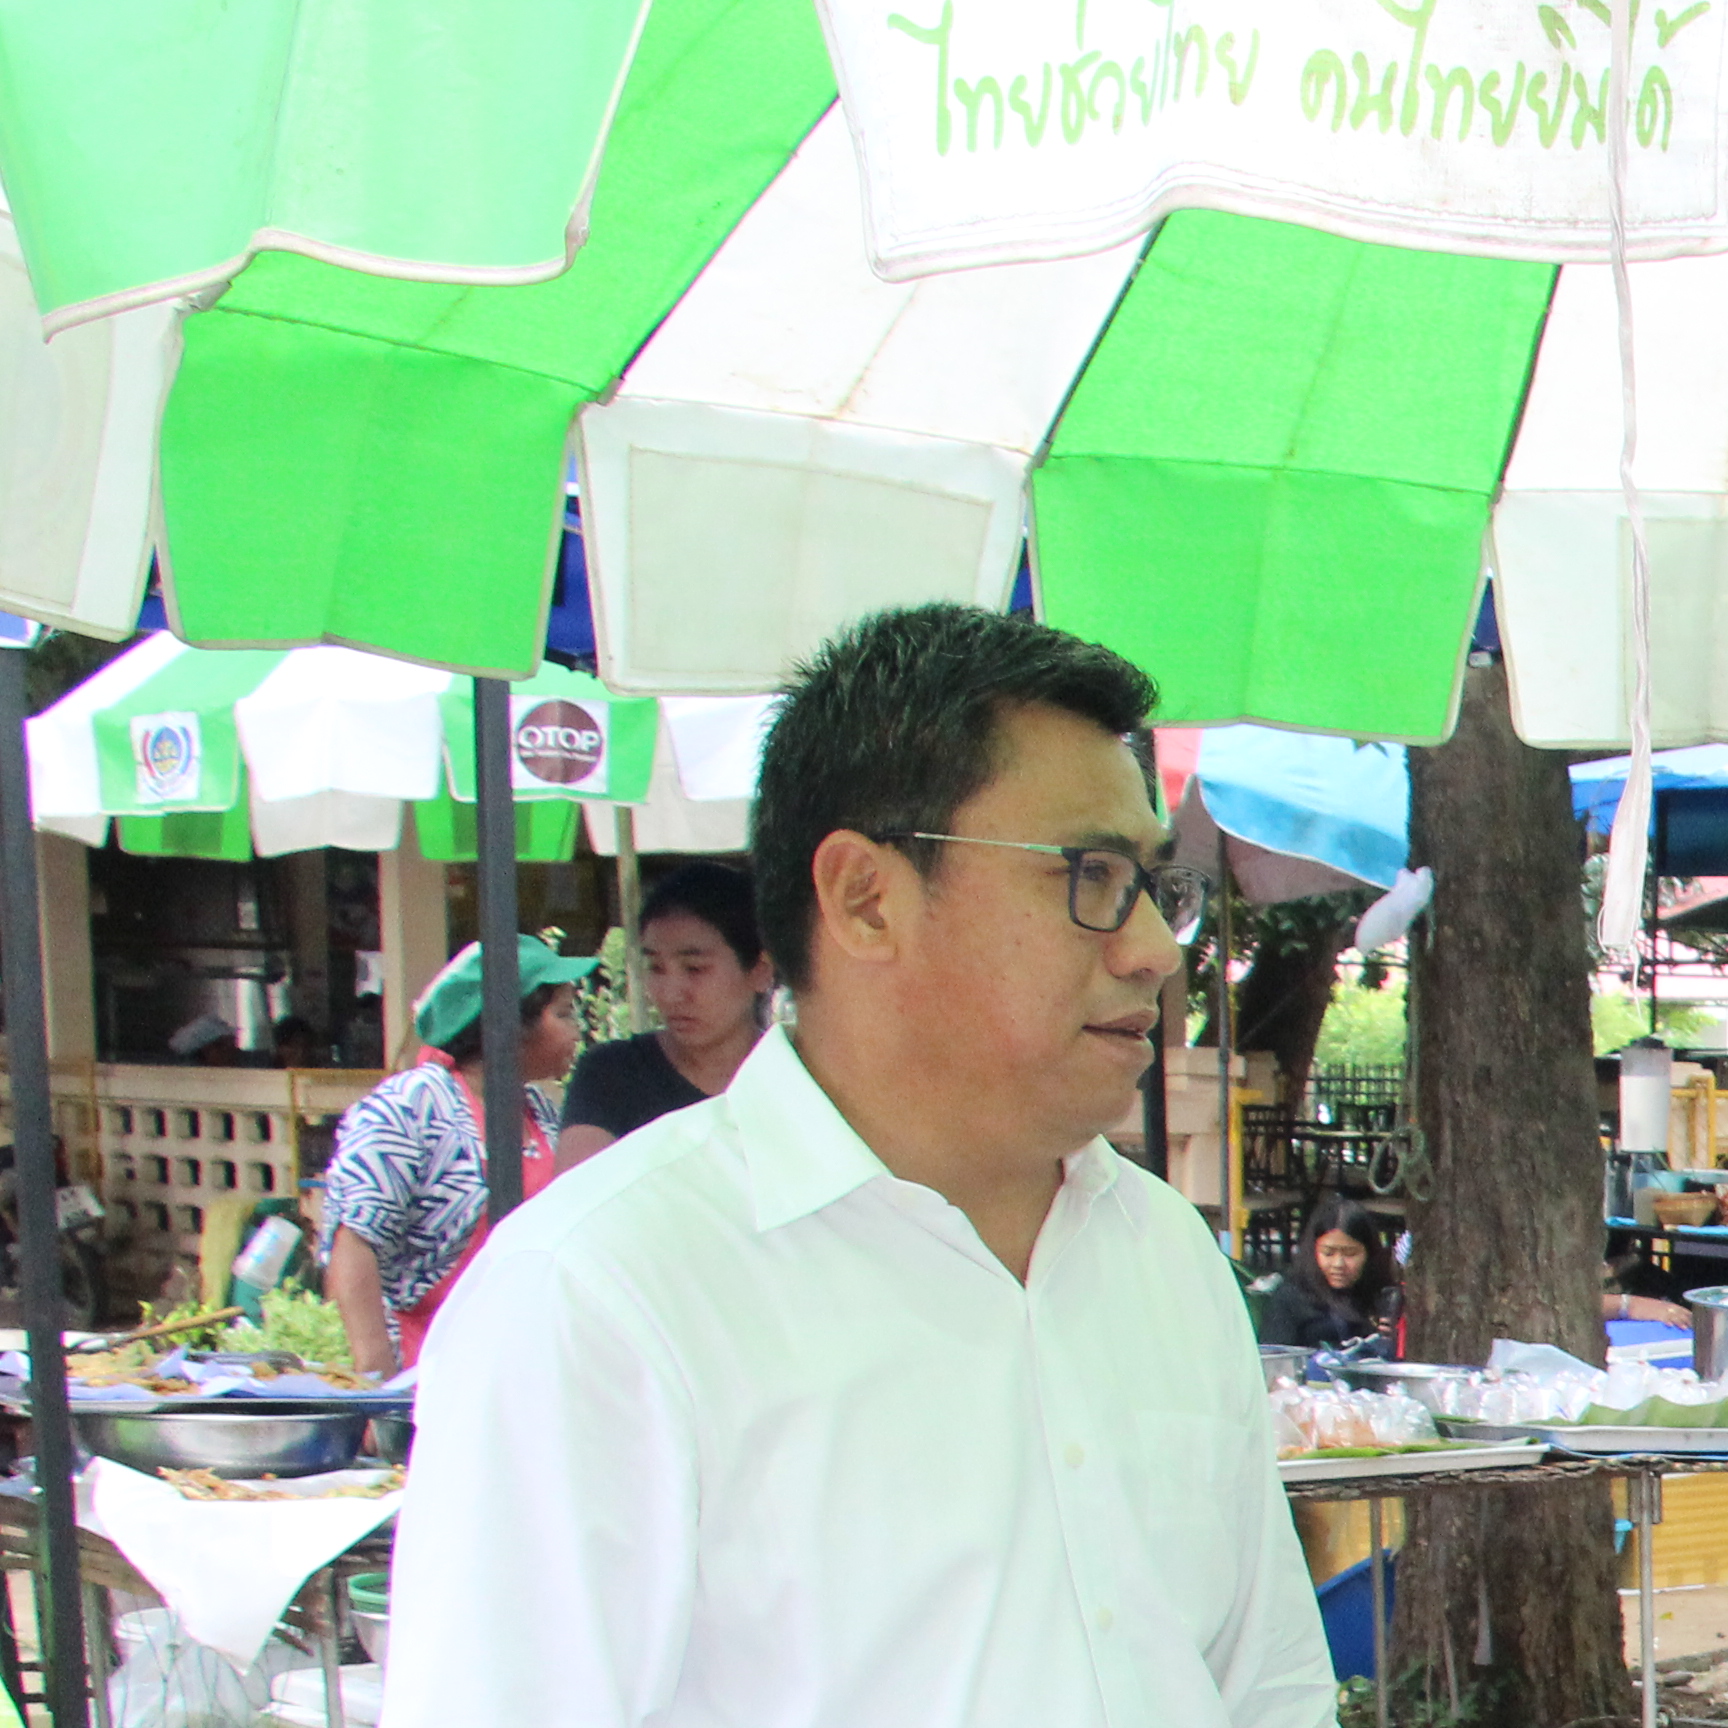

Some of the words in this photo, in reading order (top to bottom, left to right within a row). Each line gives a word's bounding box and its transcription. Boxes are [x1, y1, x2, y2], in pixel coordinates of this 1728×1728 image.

[1300, 0, 1711, 153] คนไทยยิมได้
[518, 725, 602, 753] OTOP
